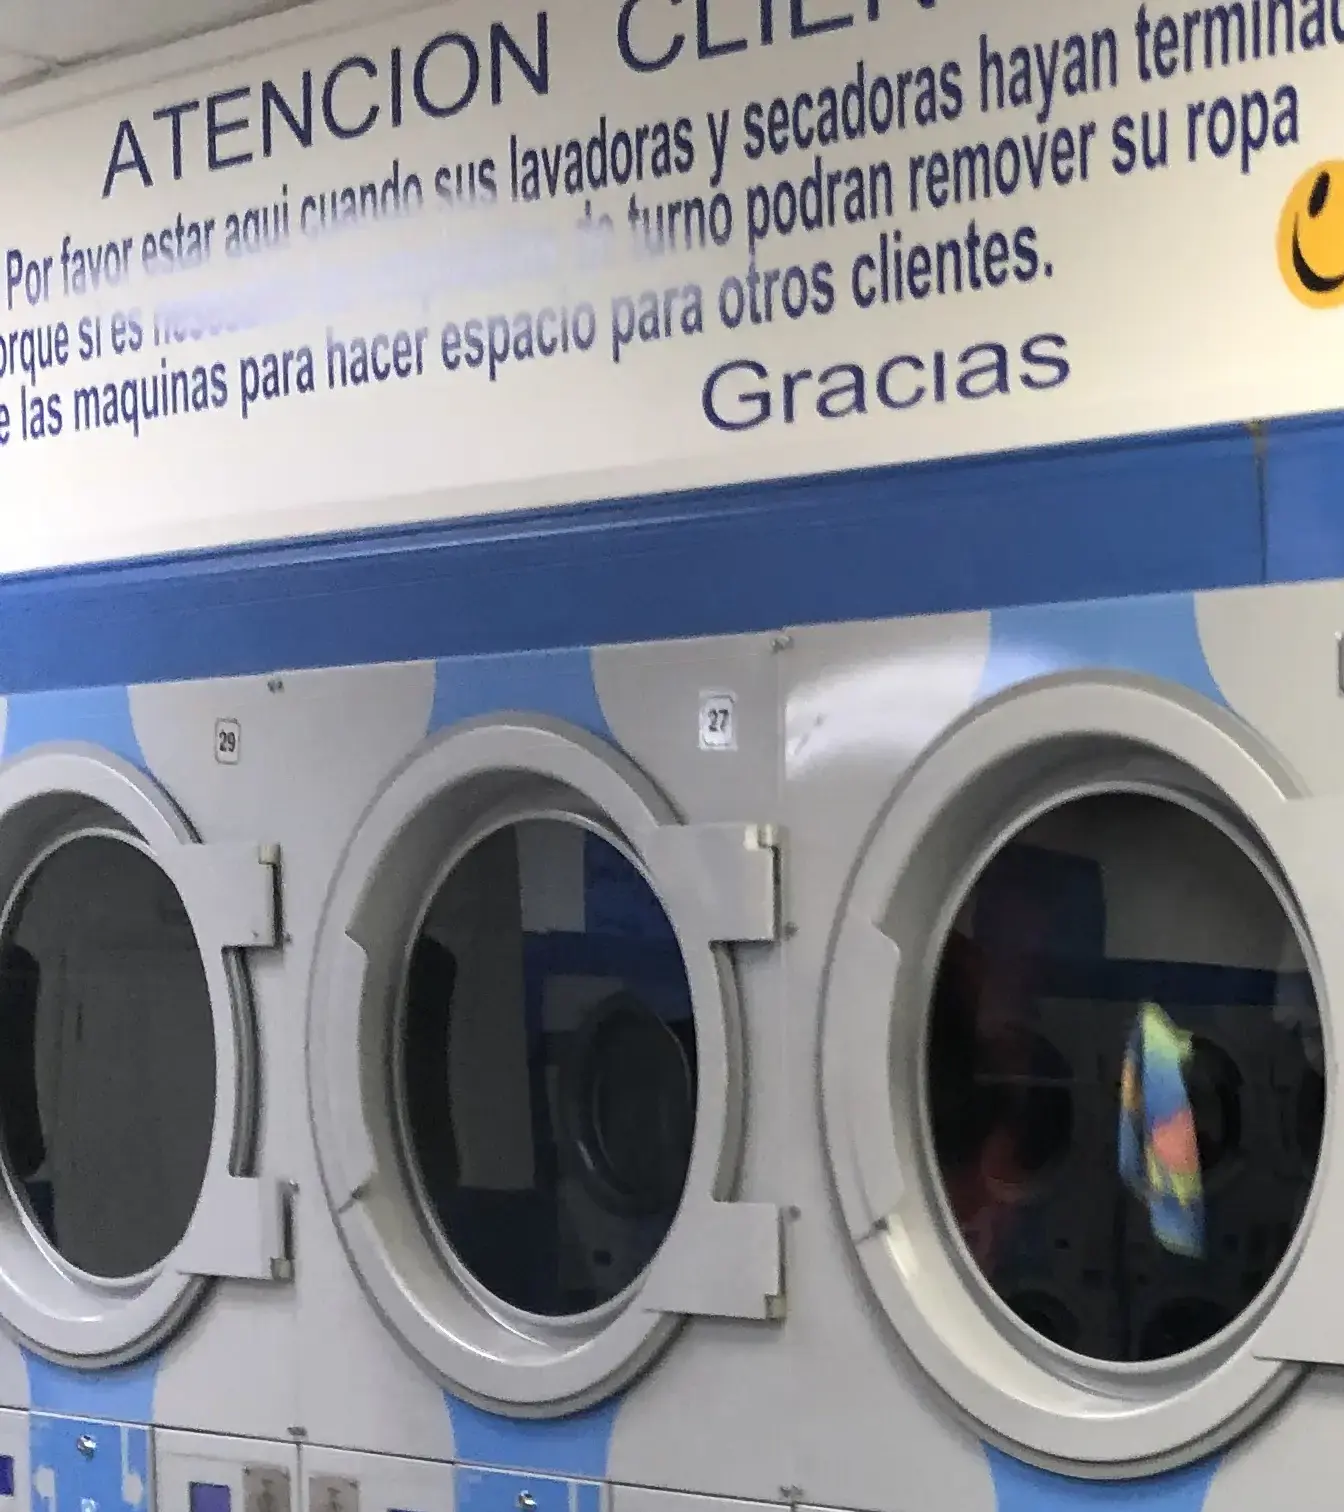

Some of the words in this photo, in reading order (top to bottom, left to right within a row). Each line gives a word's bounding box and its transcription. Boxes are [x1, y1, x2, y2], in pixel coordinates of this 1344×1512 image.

[6, 248, 53, 311] Por
[60, 235, 133, 296] favor
[141, 211, 215, 277] estar
[510, 116, 694, 202] lavadoras
[707, 107, 731, 185] y
[742, 60, 962, 161] secadoras
[979, 27, 1118, 123] hayan
[102, 11, 550, 197] ATENCION
[111, 307, 143, 355] es
[628, 191, 732, 261] turno
[747, 158, 893, 258] podran
[908, 118, 1097, 212] remover
[1112, 108, 1168, 176] su
[1187, 83, 1300, 175] ropa
[21, 384, 63, 441] las
[74, 357, 228, 438] maquinas
[240, 345, 314, 419] para
[327, 325, 430, 394] hacer
[441, 300, 596, 381] espacio
[611, 281, 703, 363] para
[719, 252, 834, 329] otros
[852, 217, 1054, 309] clientes.
[702, 332, 1071, 432] Gracias
[219, 730, 236, 752] 29
